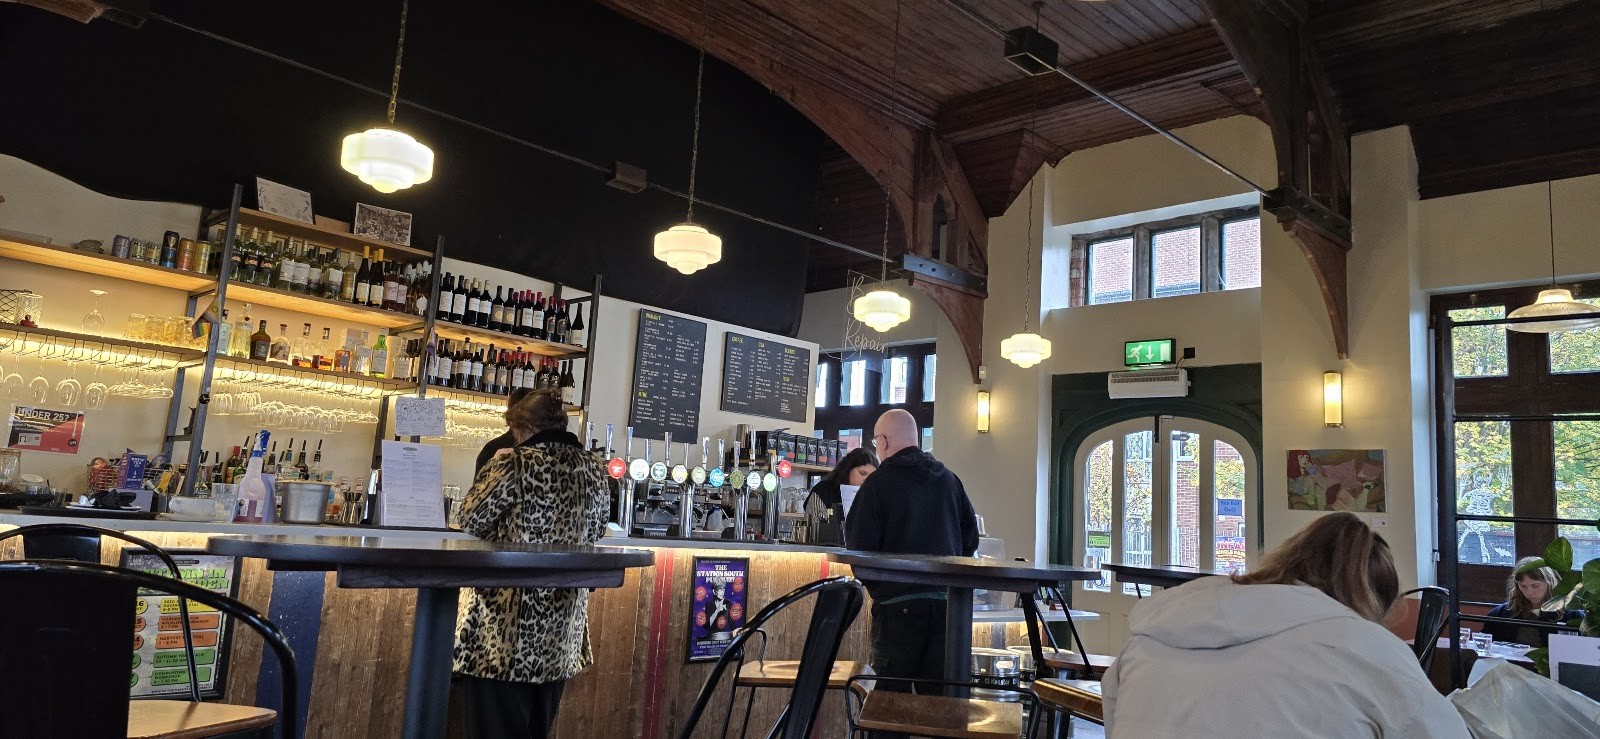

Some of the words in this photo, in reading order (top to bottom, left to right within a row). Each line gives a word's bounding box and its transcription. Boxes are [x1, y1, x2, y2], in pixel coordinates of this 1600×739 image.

[844, 318, 888, 357] Repair
[17, 407, 51, 420] UNDER
[53, 413, 70, 422] 25?
[208, 568, 227, 579] IN
